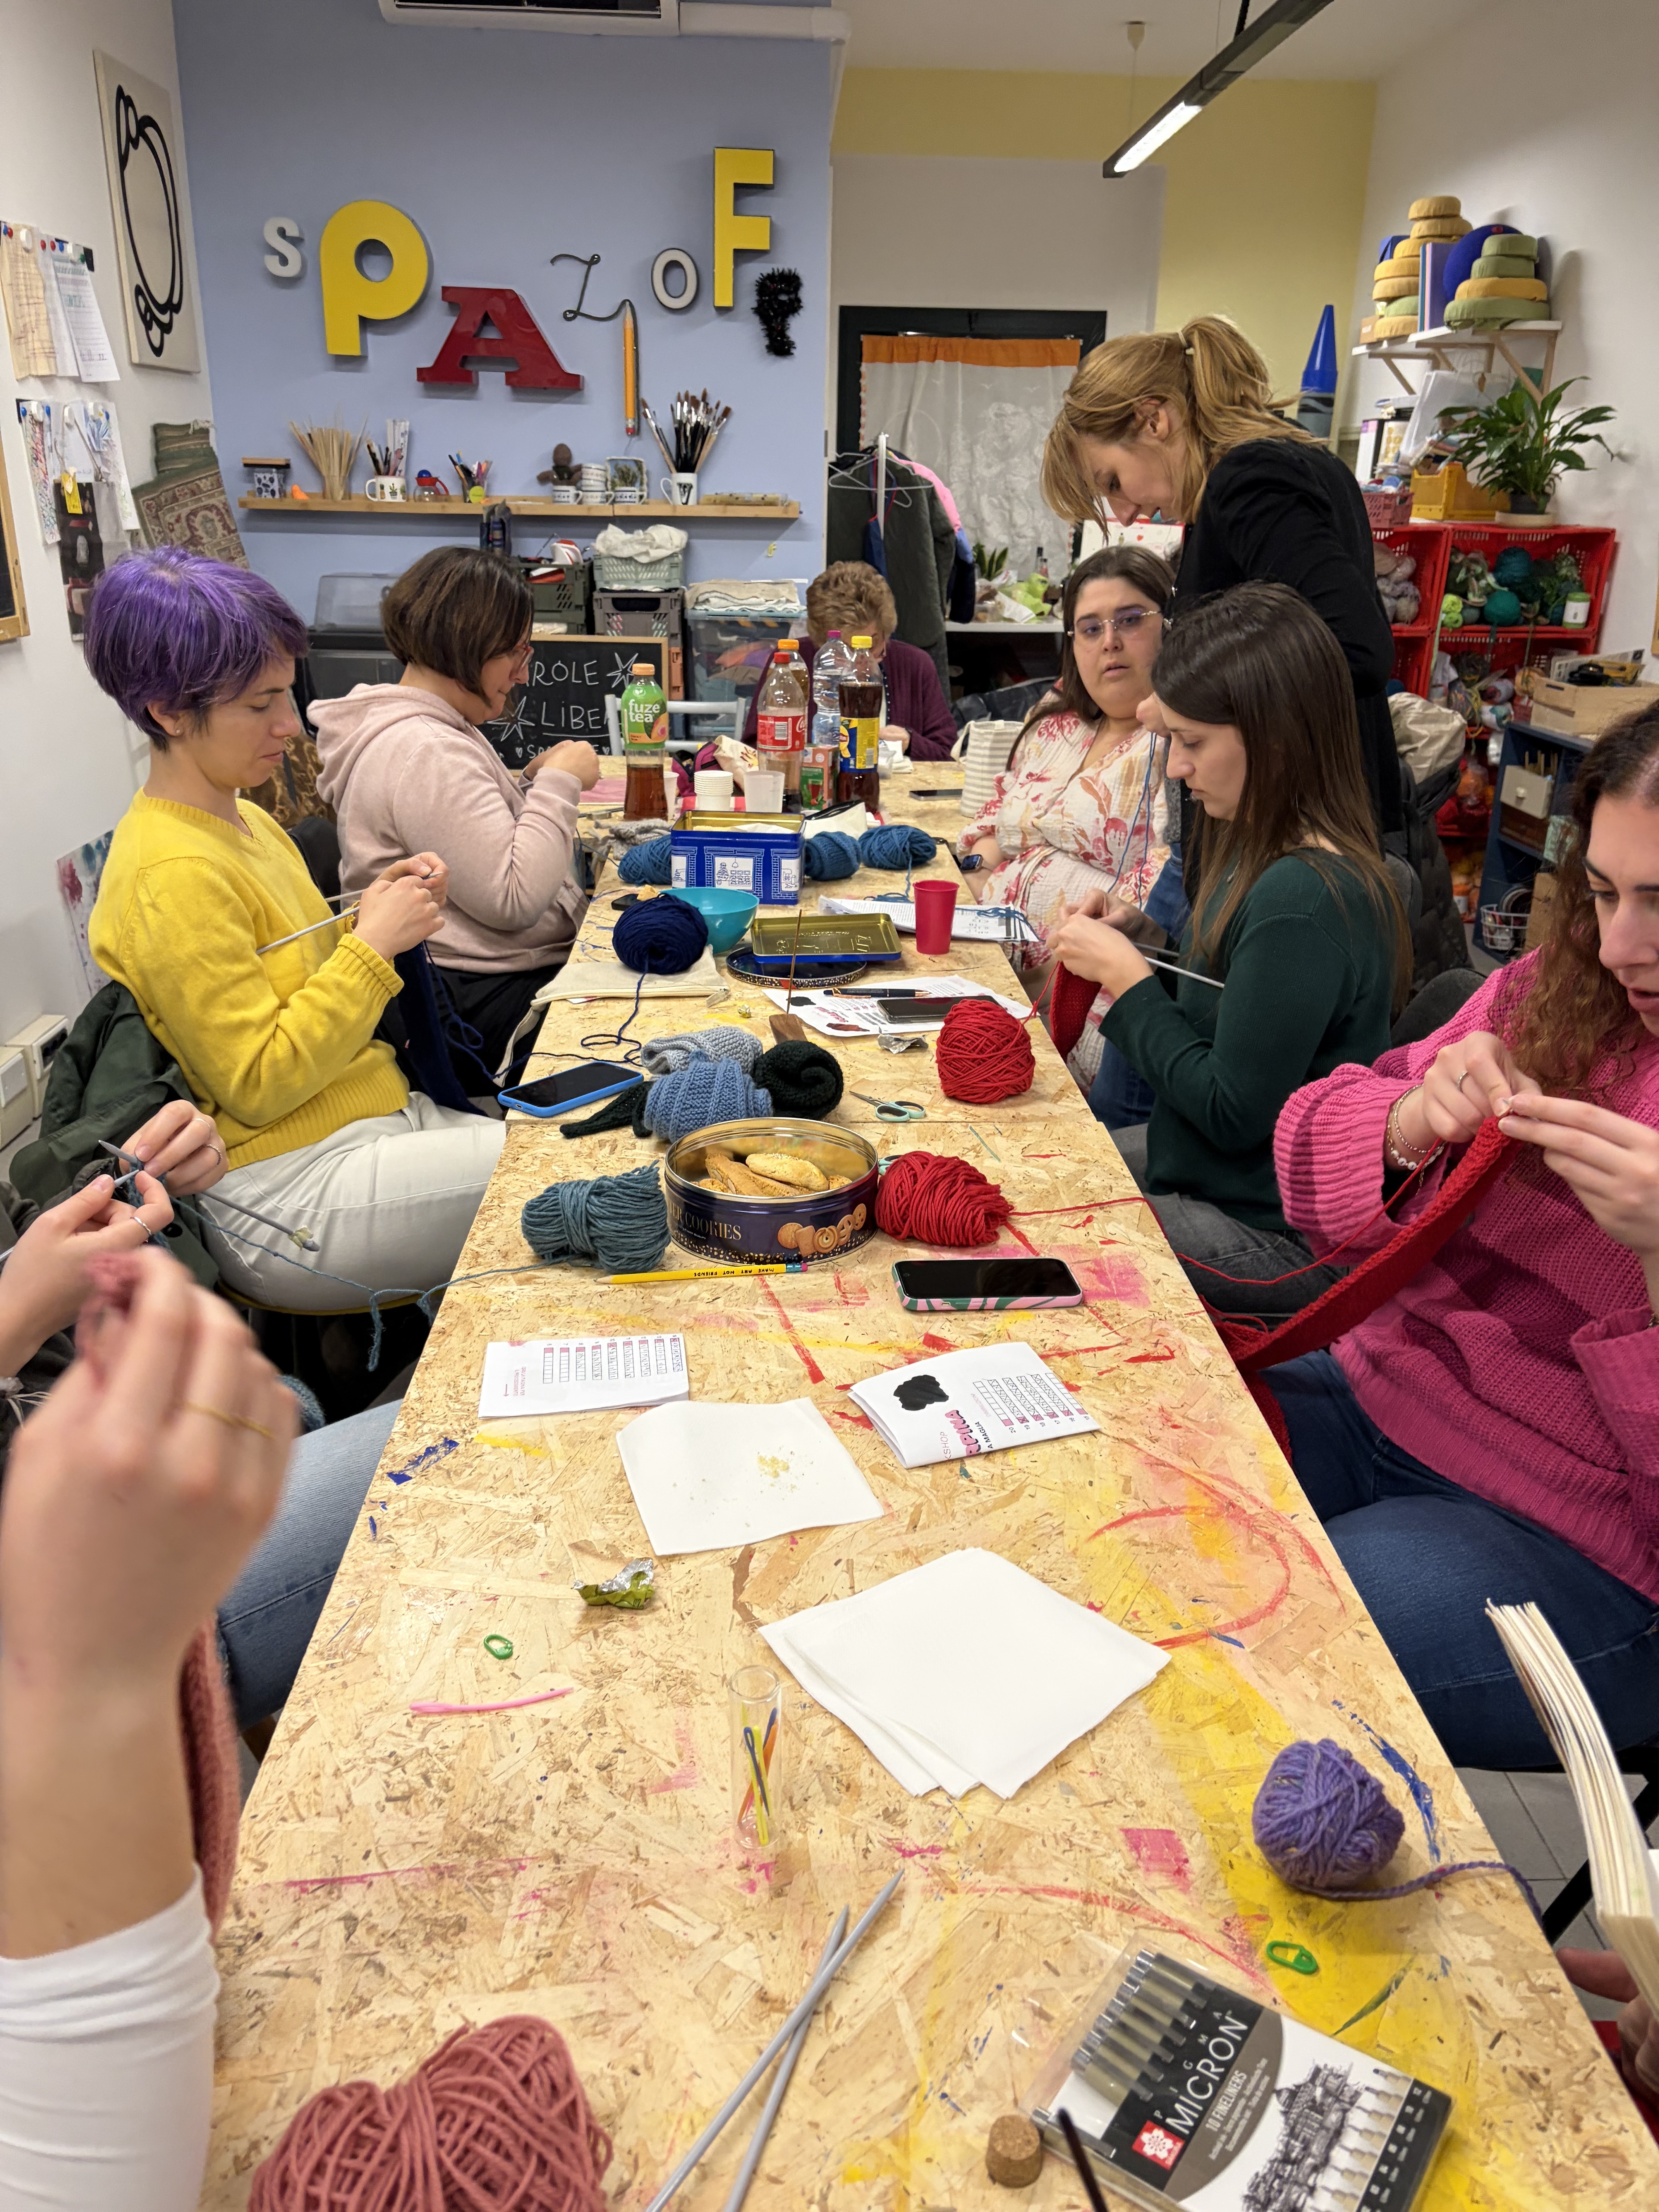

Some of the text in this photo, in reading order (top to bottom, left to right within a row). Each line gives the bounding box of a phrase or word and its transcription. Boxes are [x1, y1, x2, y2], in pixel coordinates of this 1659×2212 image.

[526, 660, 599, 687] ROLE
[629, 699, 660, 713] fuze
[629, 712, 653, 723] tea
[685, 1212, 741, 1240] COOKIES
[975, 1421, 991, 1443] MAGLIA
[1154, 2011, 1222, 2119] PIGMA
[1206, 2069, 1247, 2131] 10 FINELINERS
